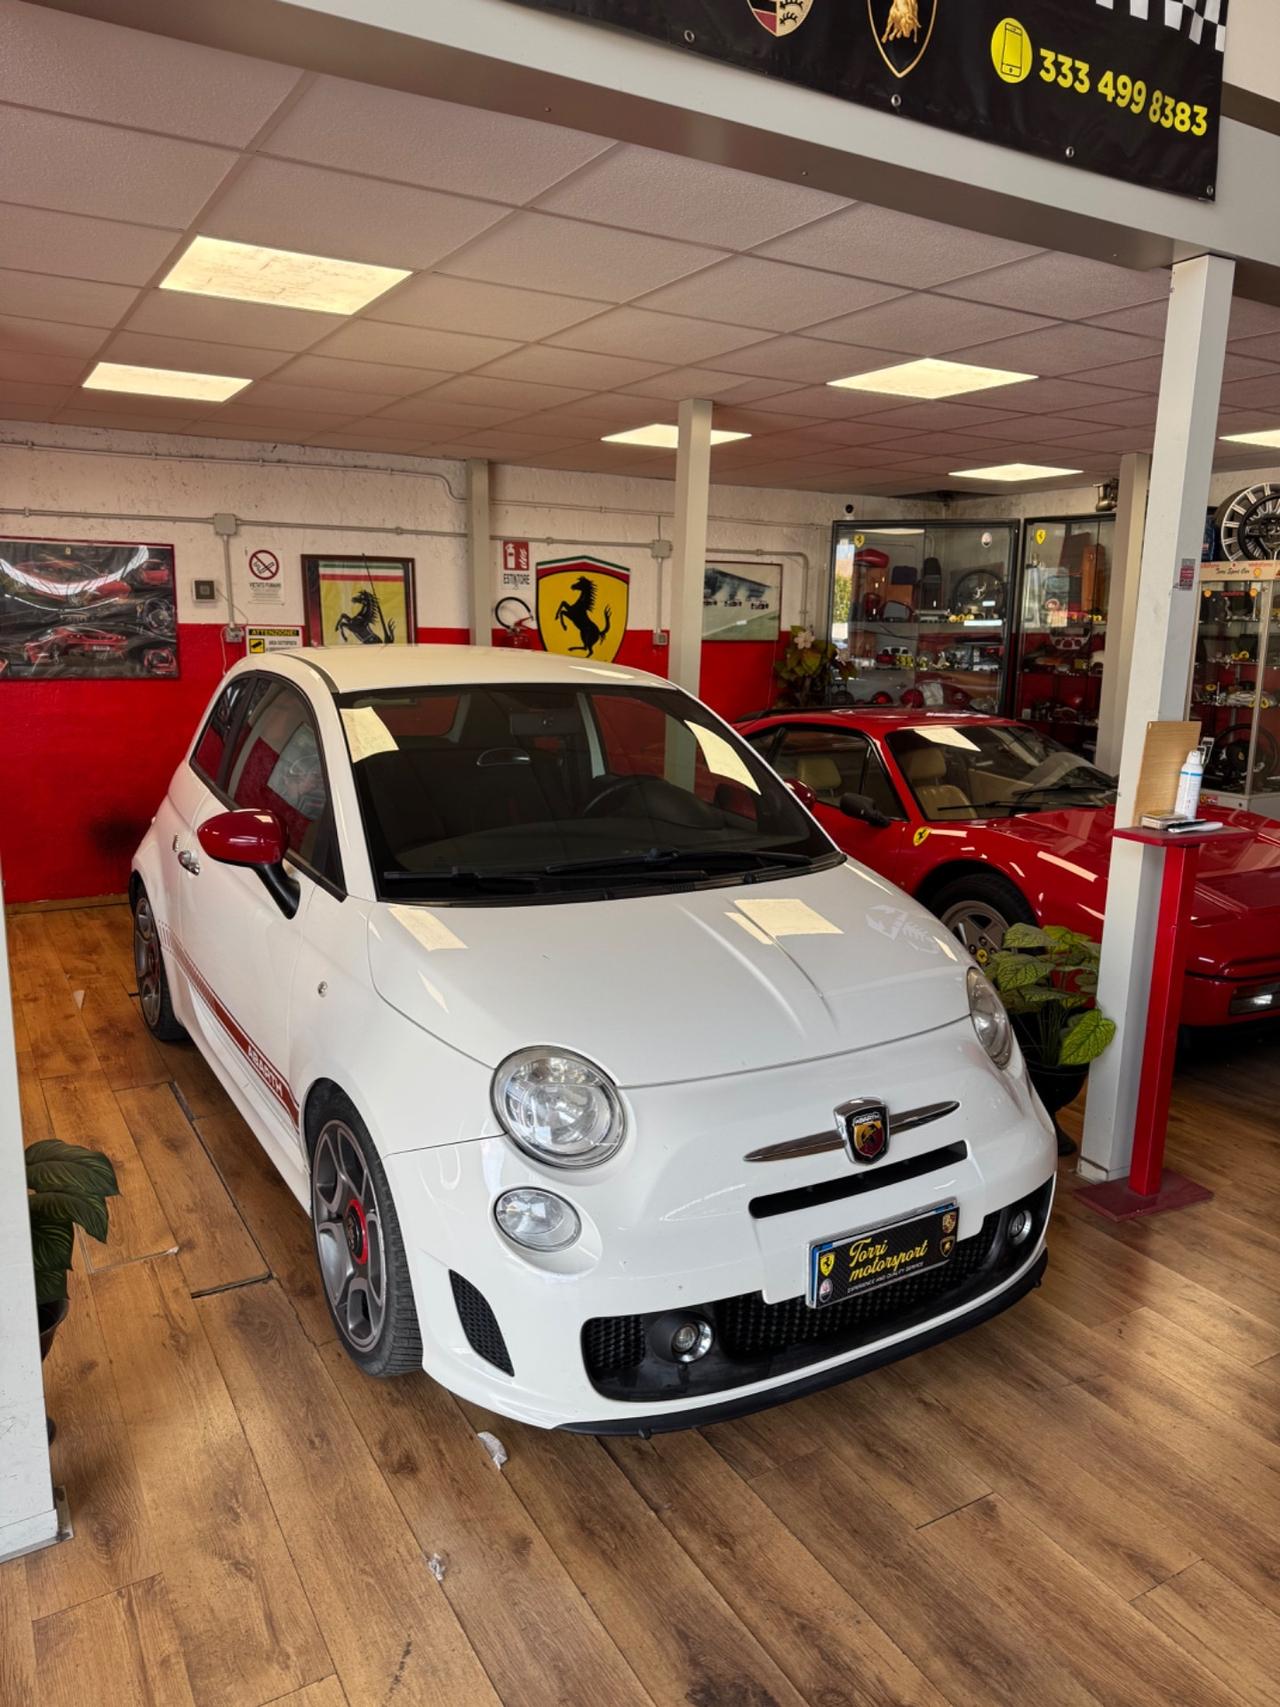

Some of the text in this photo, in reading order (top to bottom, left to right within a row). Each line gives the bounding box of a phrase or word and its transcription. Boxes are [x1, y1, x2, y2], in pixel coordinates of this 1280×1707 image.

[1039, 47, 1208, 137] 333 499 8383
[848, 1237, 888, 1268] Torri
[848, 1239, 929, 1283] motorsport
